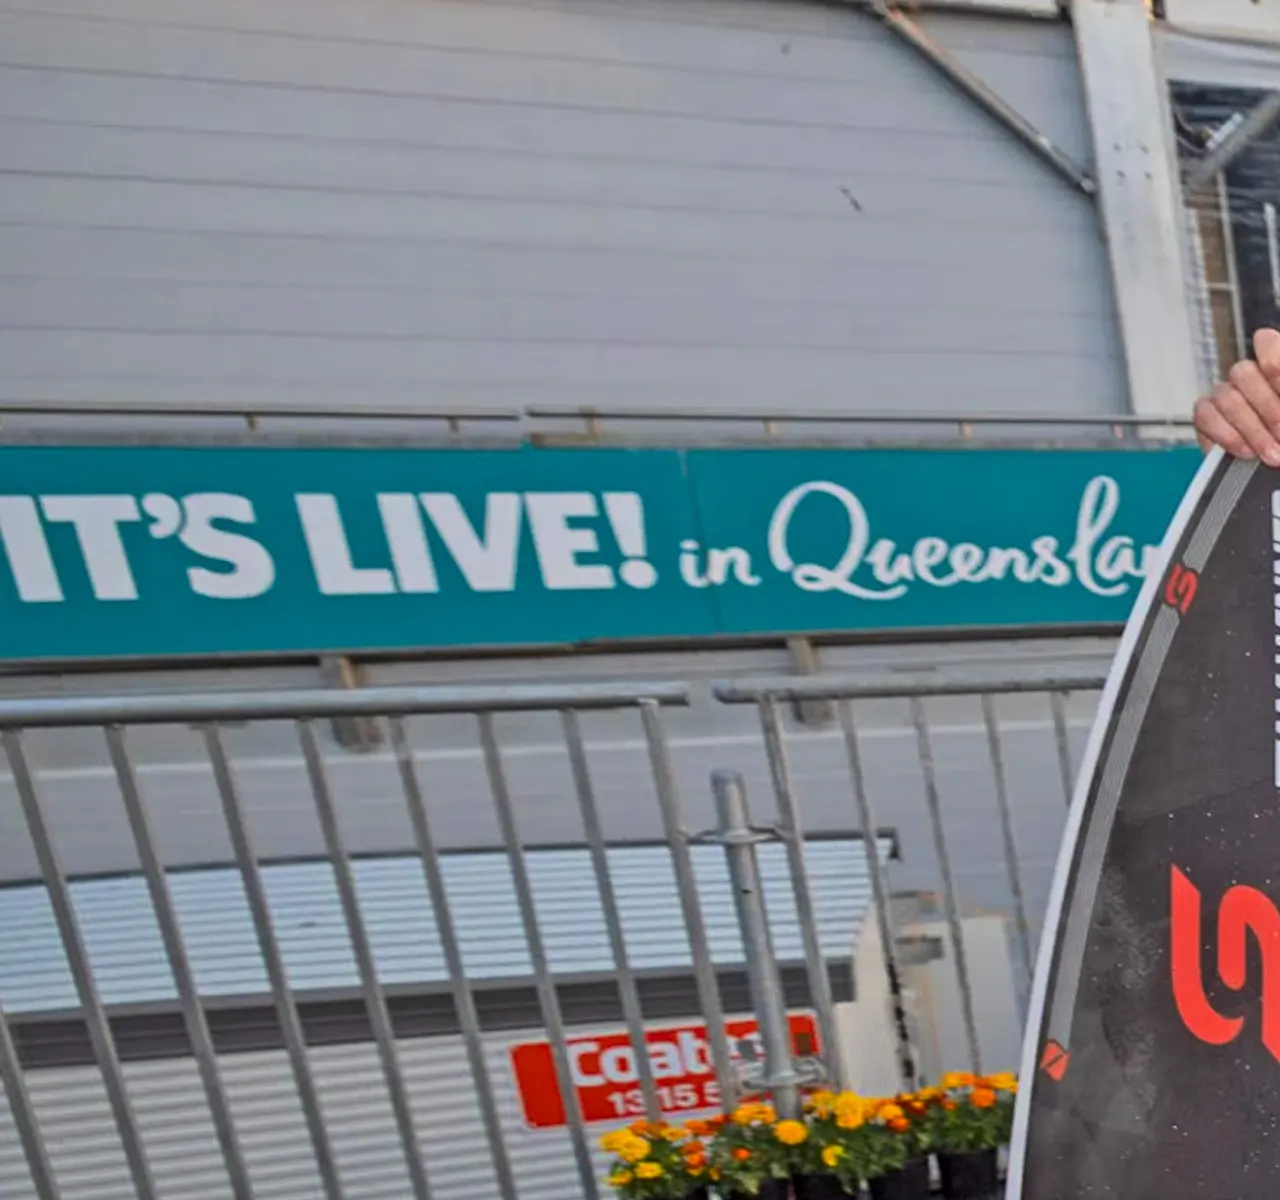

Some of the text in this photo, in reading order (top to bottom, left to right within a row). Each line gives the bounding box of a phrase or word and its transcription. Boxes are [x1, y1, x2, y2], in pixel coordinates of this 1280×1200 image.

[0, 475, 1162, 602] IT'S LIVE! in Queensla
